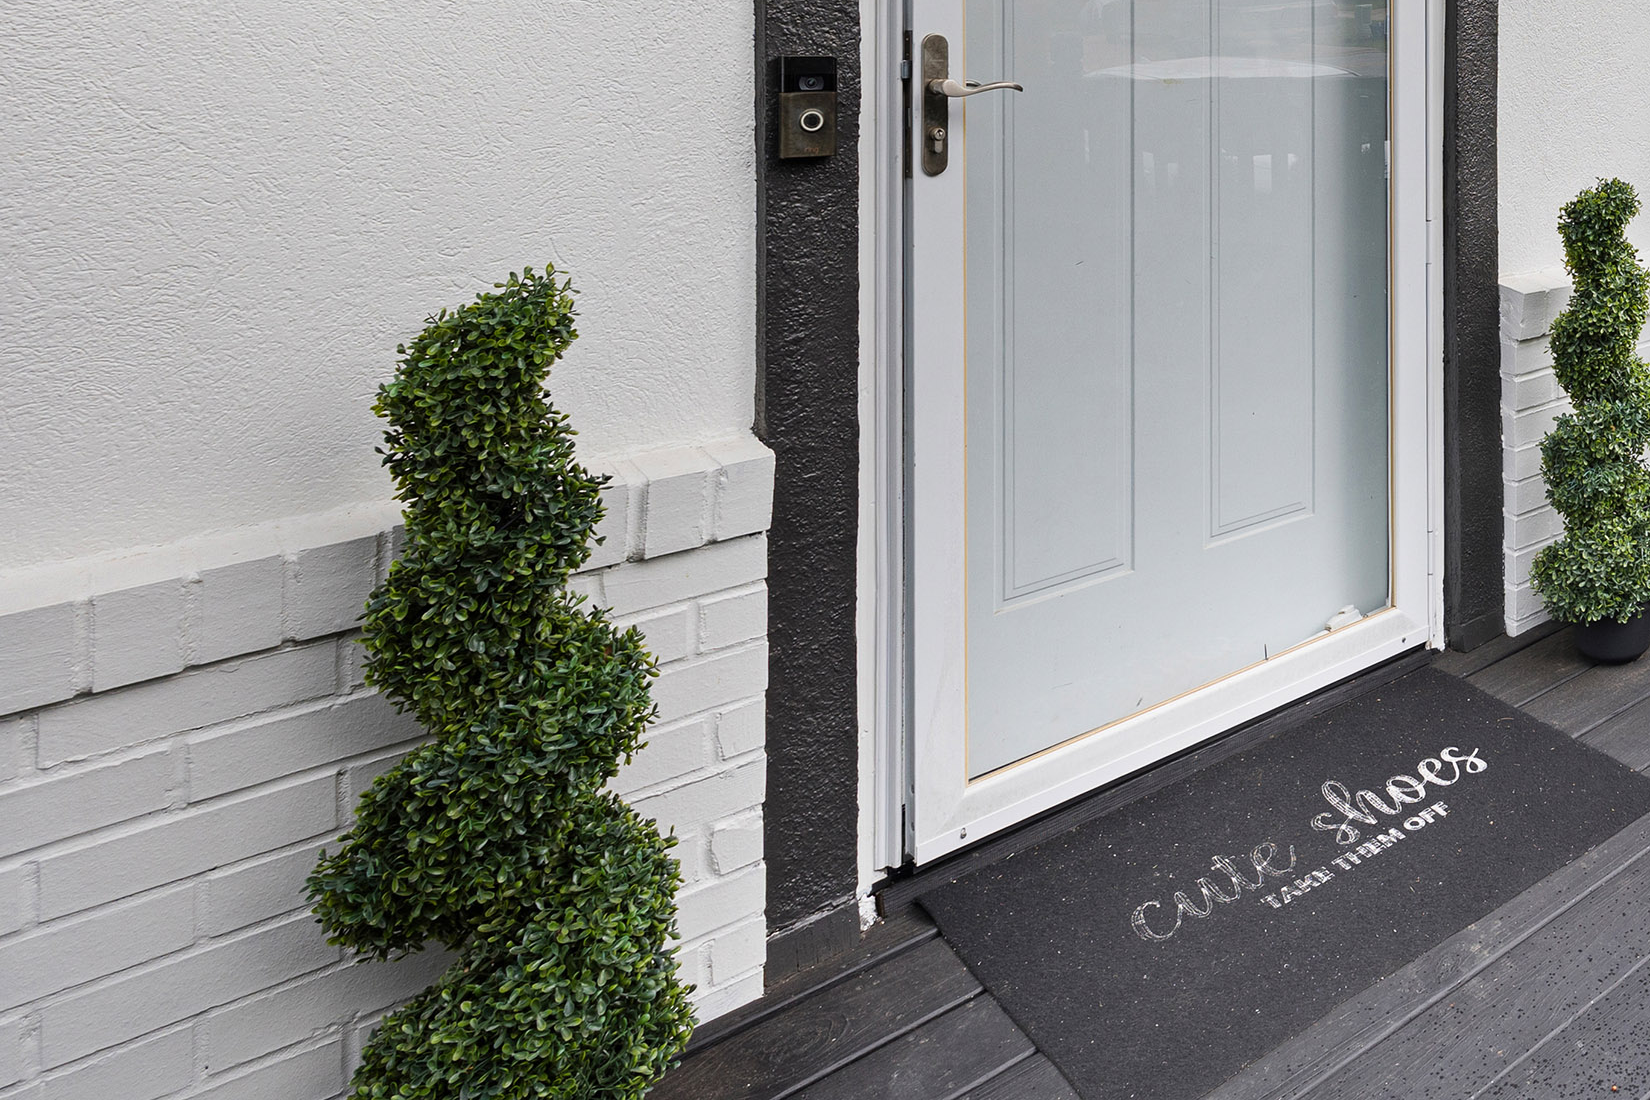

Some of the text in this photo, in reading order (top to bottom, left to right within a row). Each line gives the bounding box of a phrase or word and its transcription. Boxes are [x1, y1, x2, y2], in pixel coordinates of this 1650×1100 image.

[1131, 842, 1297, 941] cute
[1260, 800, 1451, 909] TAKE THEM OFF
